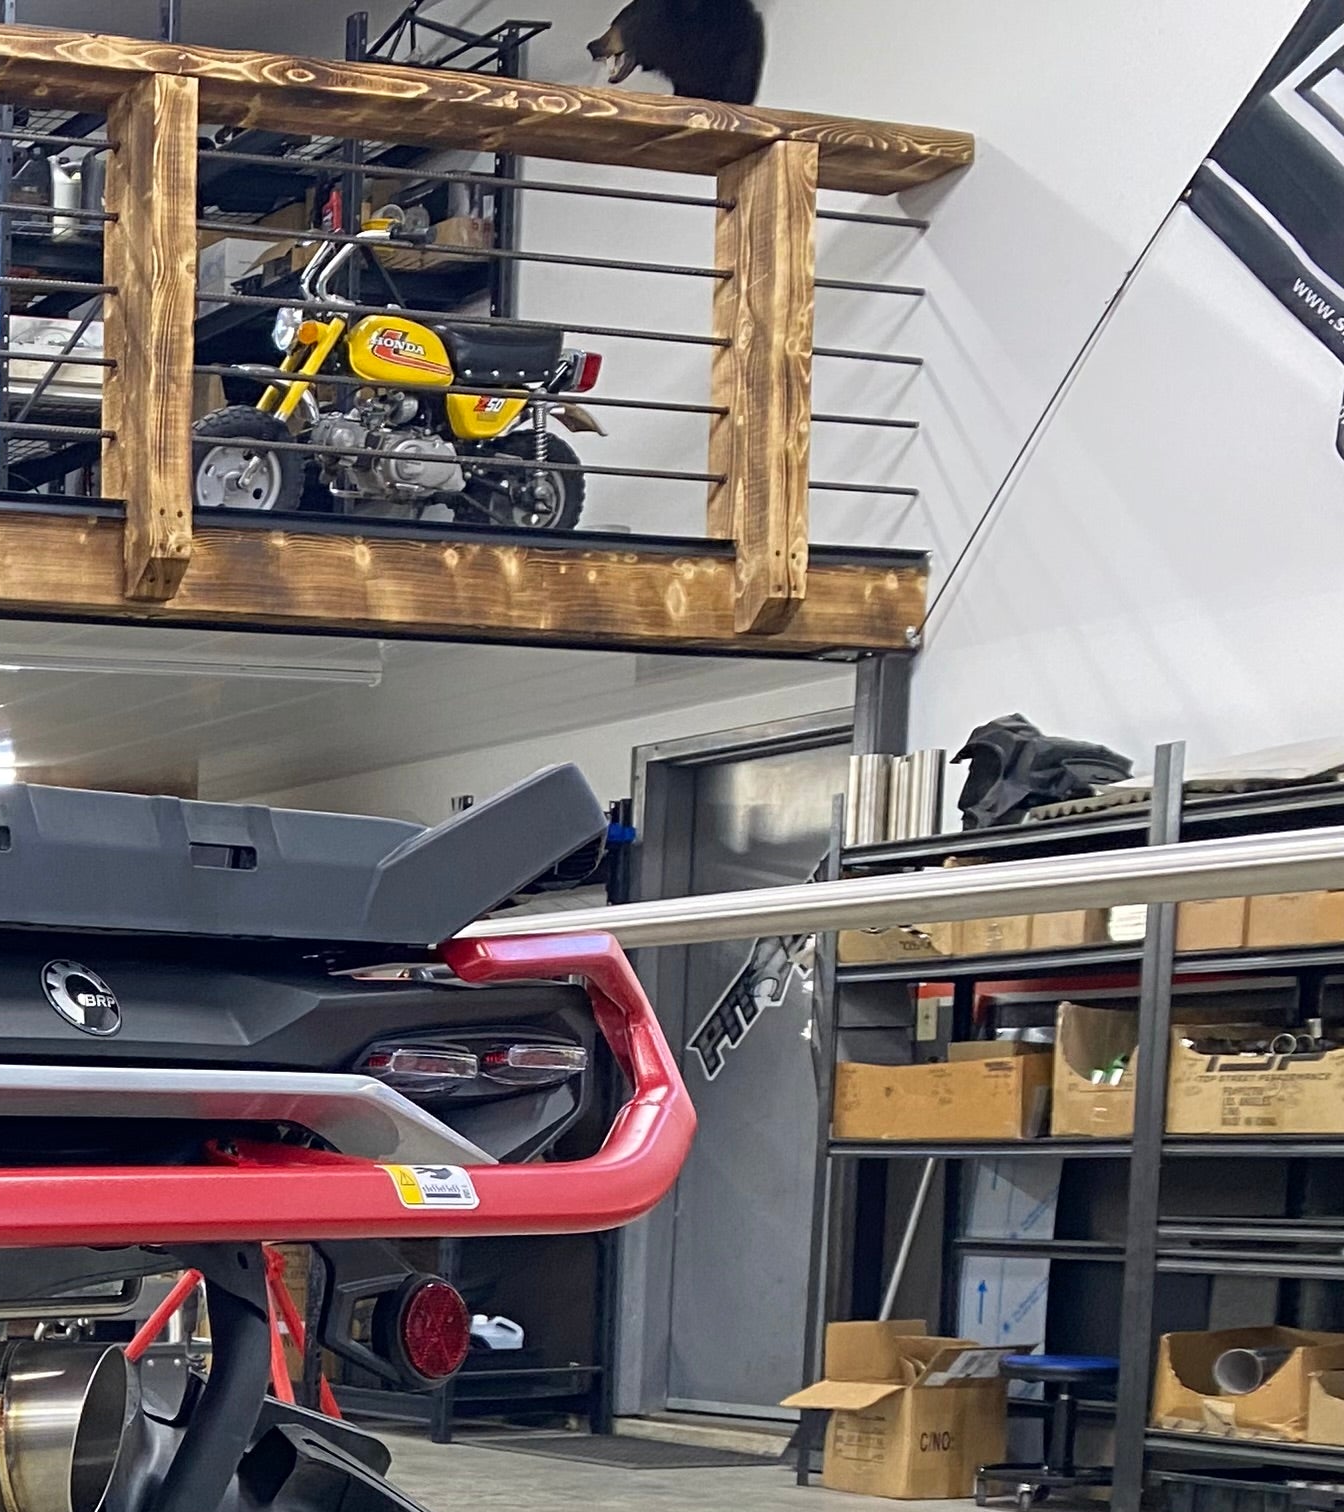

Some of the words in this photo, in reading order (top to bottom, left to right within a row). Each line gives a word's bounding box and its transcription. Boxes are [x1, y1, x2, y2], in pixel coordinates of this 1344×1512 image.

[1291, 277, 1344, 338] www.s
[370, 334, 426, 356] HONDA
[473, 395, 506, 412] Z50
[85, 993, 116, 1008] BRP
